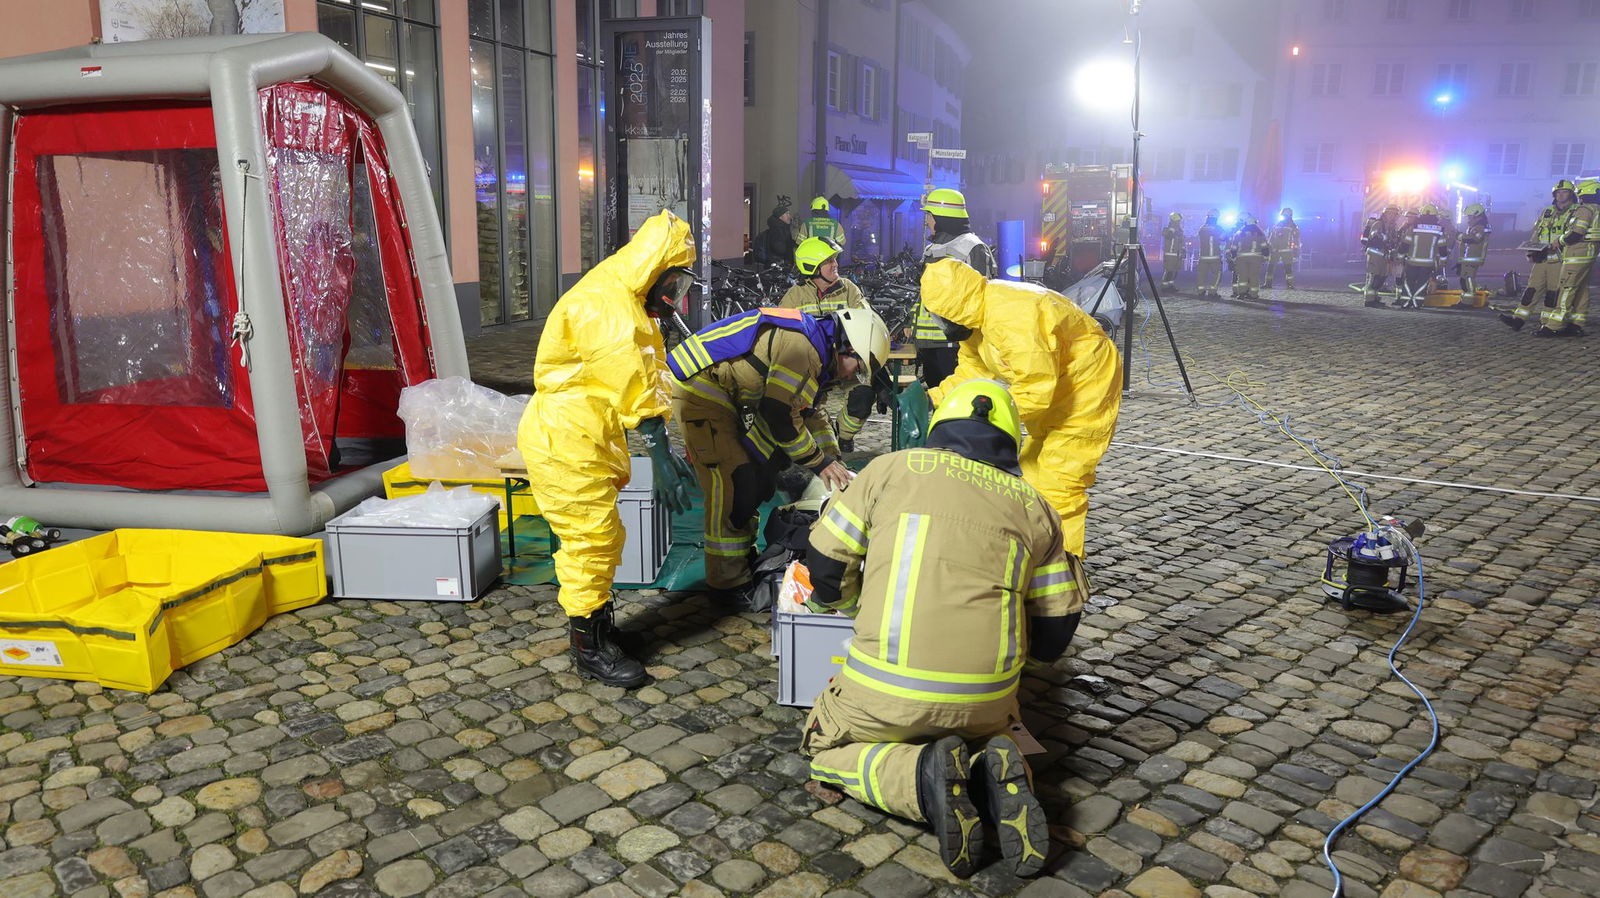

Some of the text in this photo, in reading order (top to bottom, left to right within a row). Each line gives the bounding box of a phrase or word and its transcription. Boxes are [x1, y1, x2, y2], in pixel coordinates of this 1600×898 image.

[663, 31, 689, 39] Jahres
[645, 40, 689, 49] Ausstellung
[630, 63, 644, 103] 2025
[934, 150, 965, 158] Münsterplatz
[945, 467, 1034, 512] KONSTANZ
